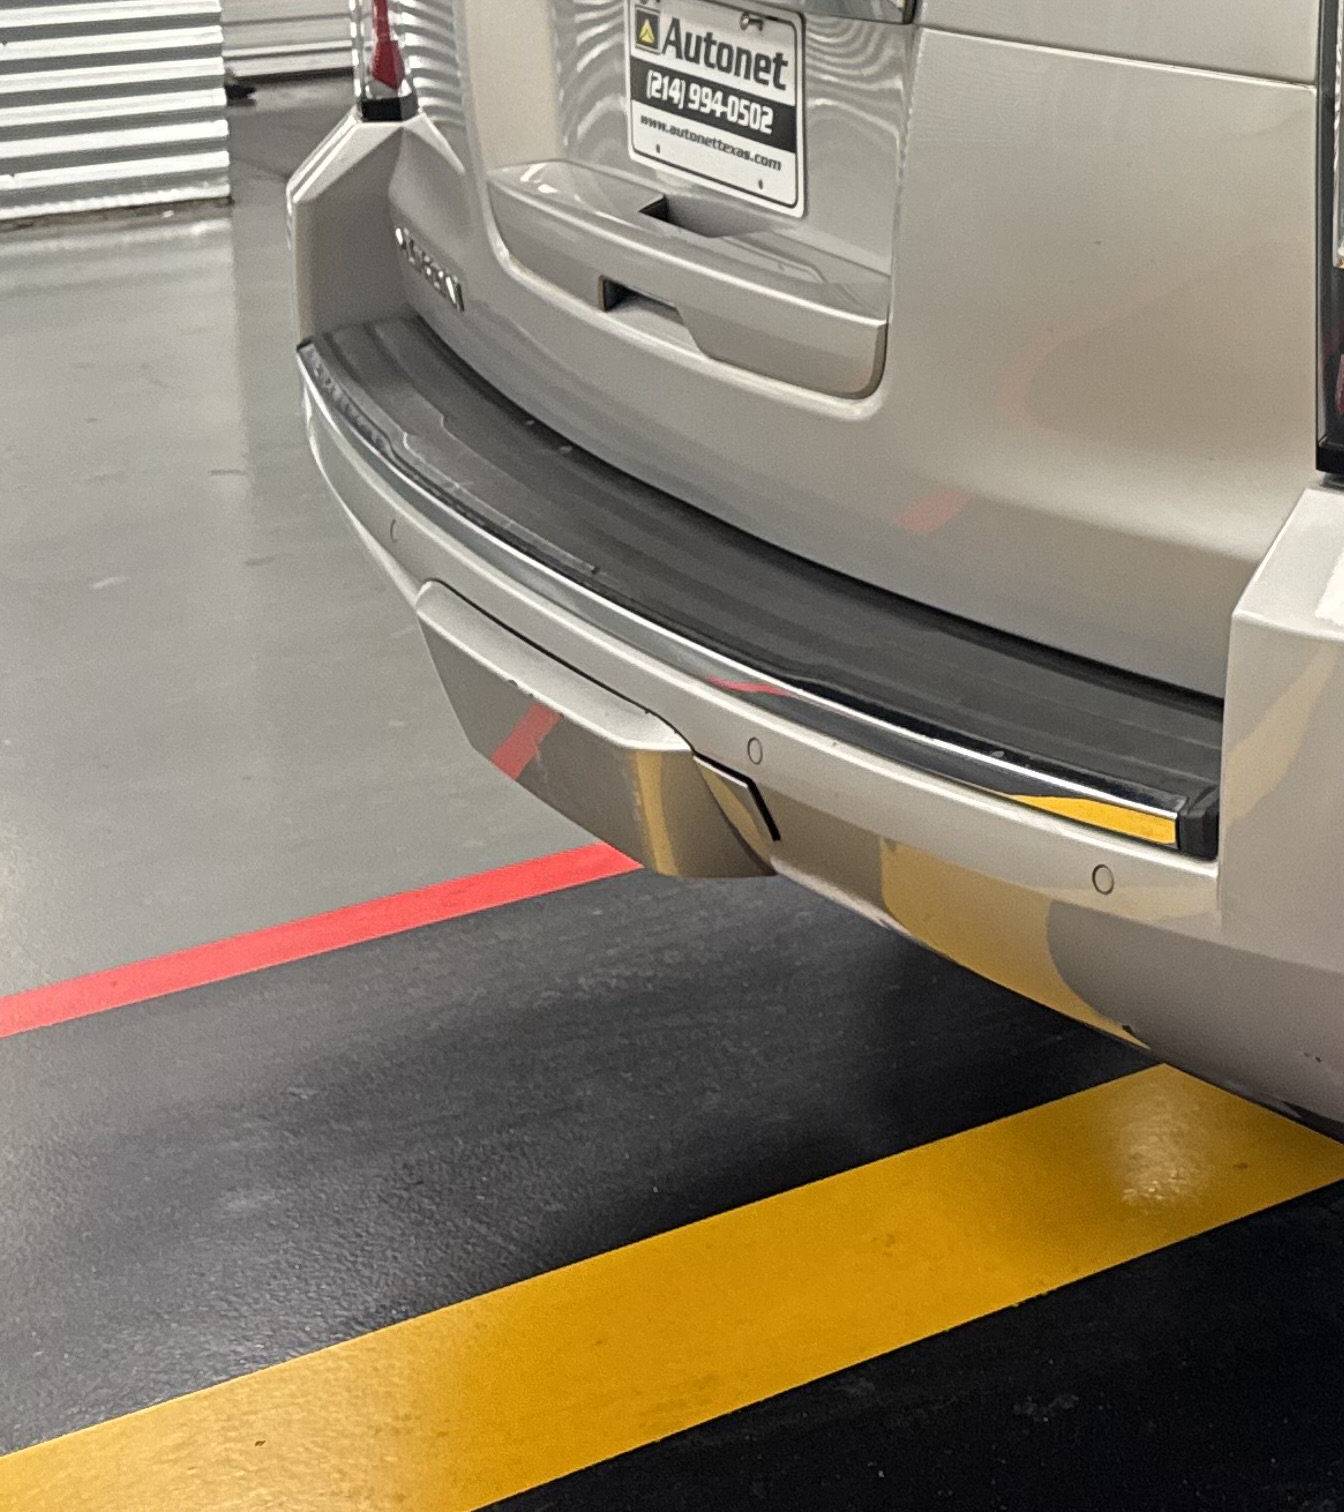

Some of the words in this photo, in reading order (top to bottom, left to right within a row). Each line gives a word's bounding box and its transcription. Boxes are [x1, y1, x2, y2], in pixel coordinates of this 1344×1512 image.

[661, 17, 789, 91] Autonet
[646, 70, 686, 109] (214)
[688, 82, 774, 135] 994-0502
[640, 114, 783, 172] www.autonettexas.com
